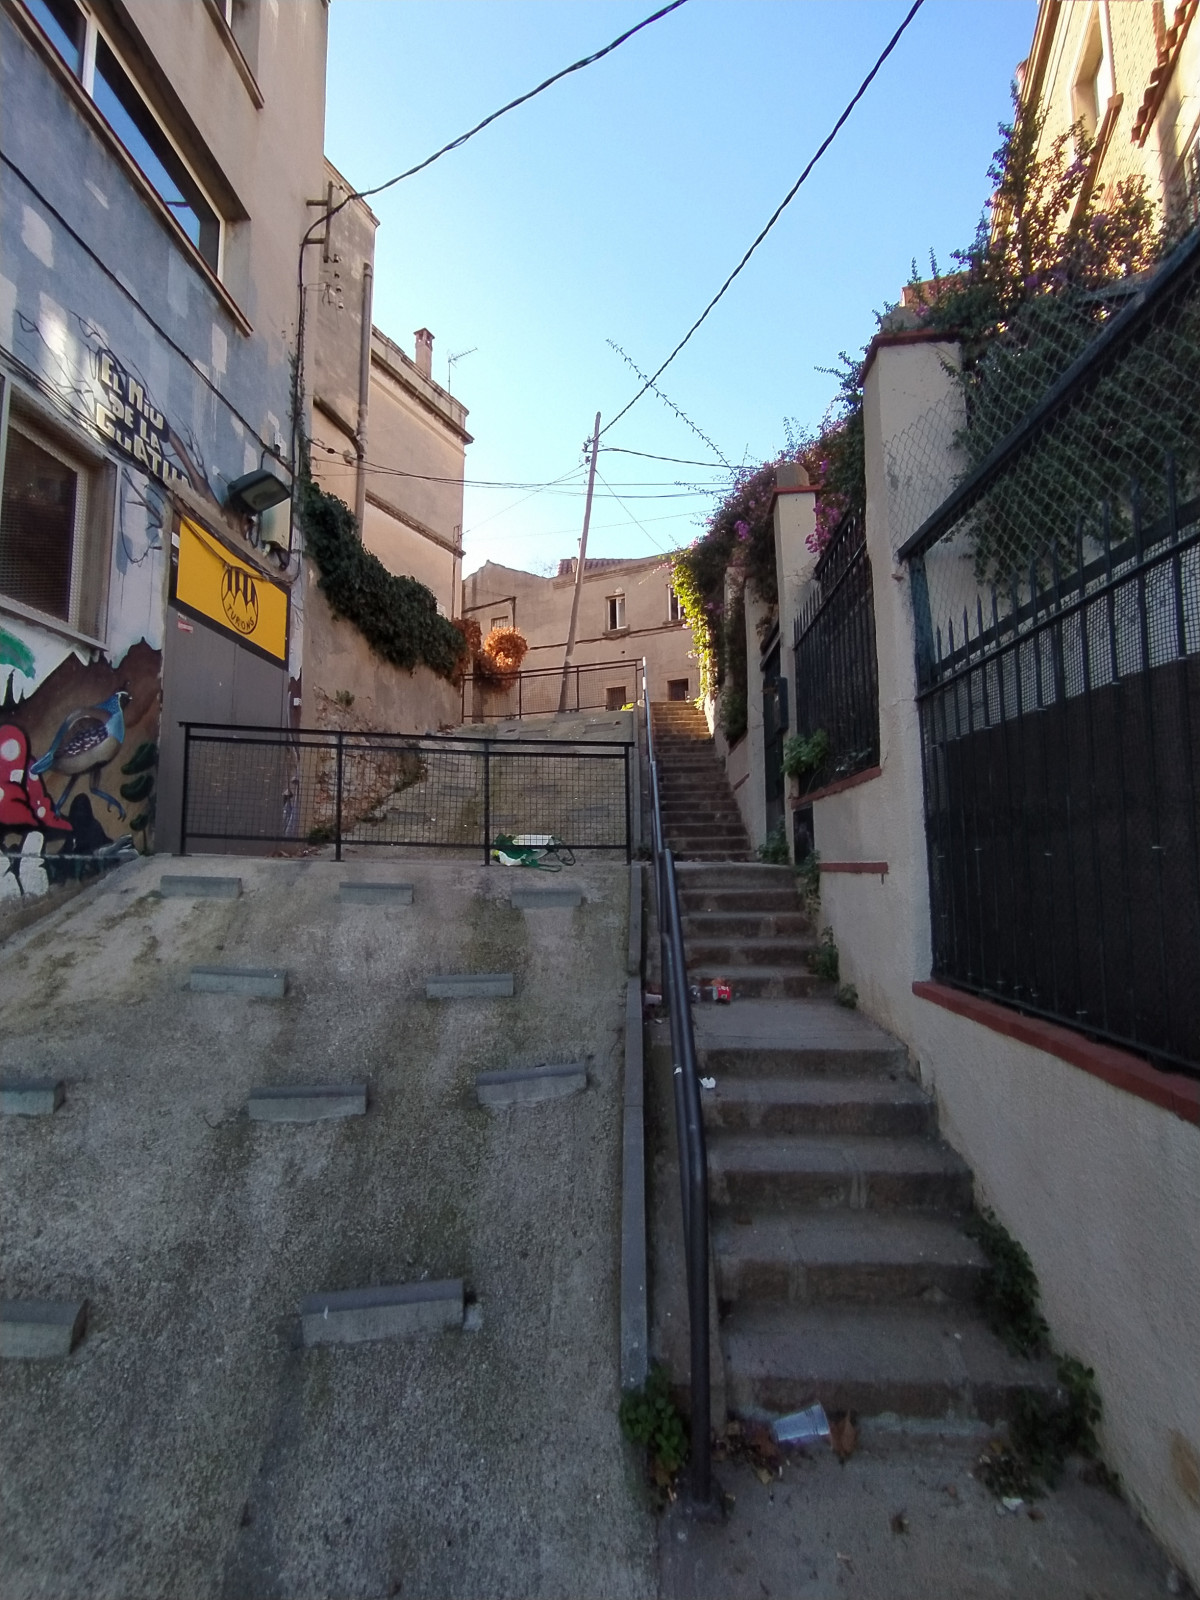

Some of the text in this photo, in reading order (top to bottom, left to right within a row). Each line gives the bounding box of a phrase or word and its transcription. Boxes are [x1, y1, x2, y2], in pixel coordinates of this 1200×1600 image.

[101, 352, 123, 396] EL
[108, 389, 162, 454] DE LA
[227, 604, 255, 631] TURONS
